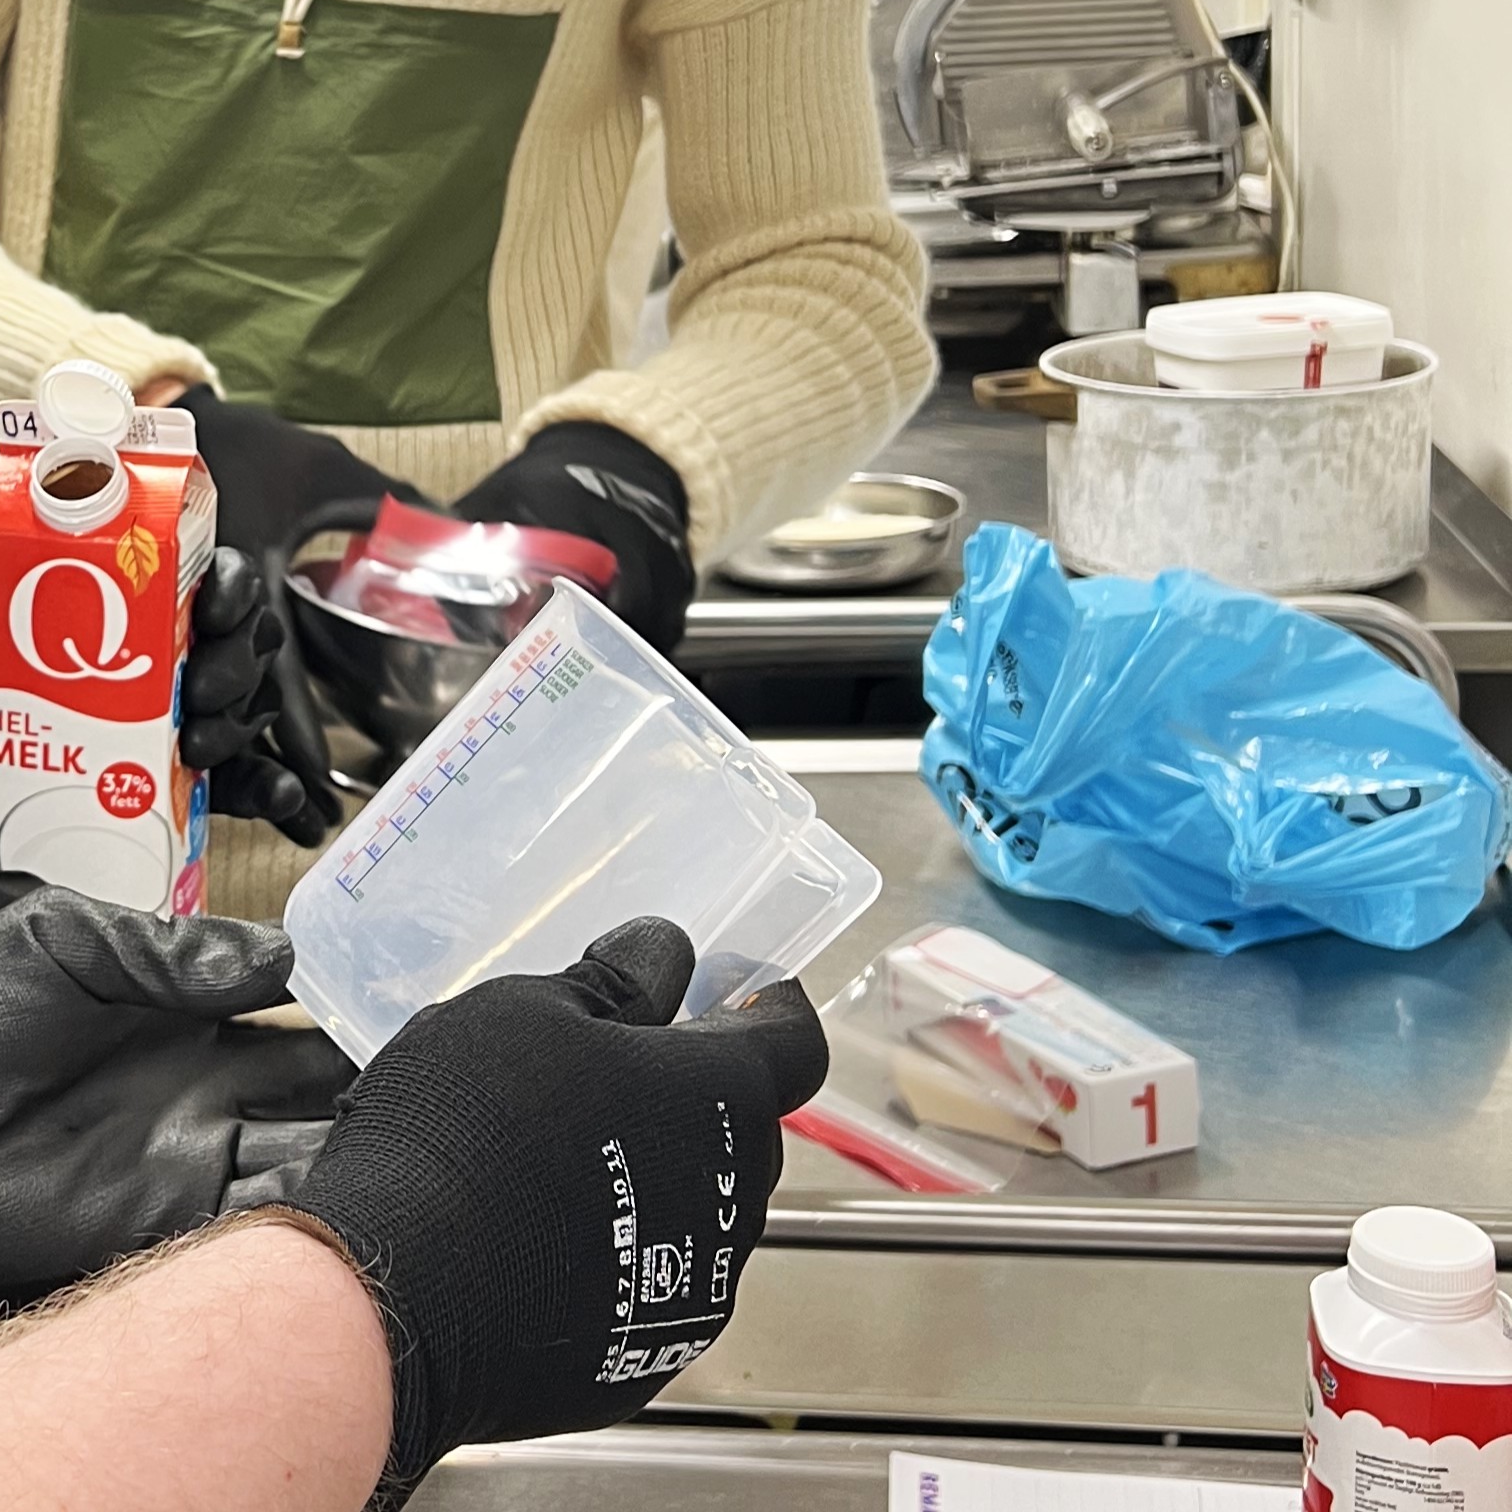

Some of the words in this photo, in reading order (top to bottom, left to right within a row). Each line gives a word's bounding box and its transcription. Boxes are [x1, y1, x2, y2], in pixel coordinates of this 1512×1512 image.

[561, 658, 585, 680] SUGAR
[101, 772, 153, 796] 3,7%
[109, 795, 142, 809] fett
[1131, 1082, 1159, 1147] 1
[601, 1138, 623, 1172] 11
[613, 1178, 631, 1210] 10
[717, 1171, 737, 1232] CE
[619, 1249, 633, 1267] 8
[618, 1276, 632, 1297] 7
[616, 1301, 629, 1318] 6
